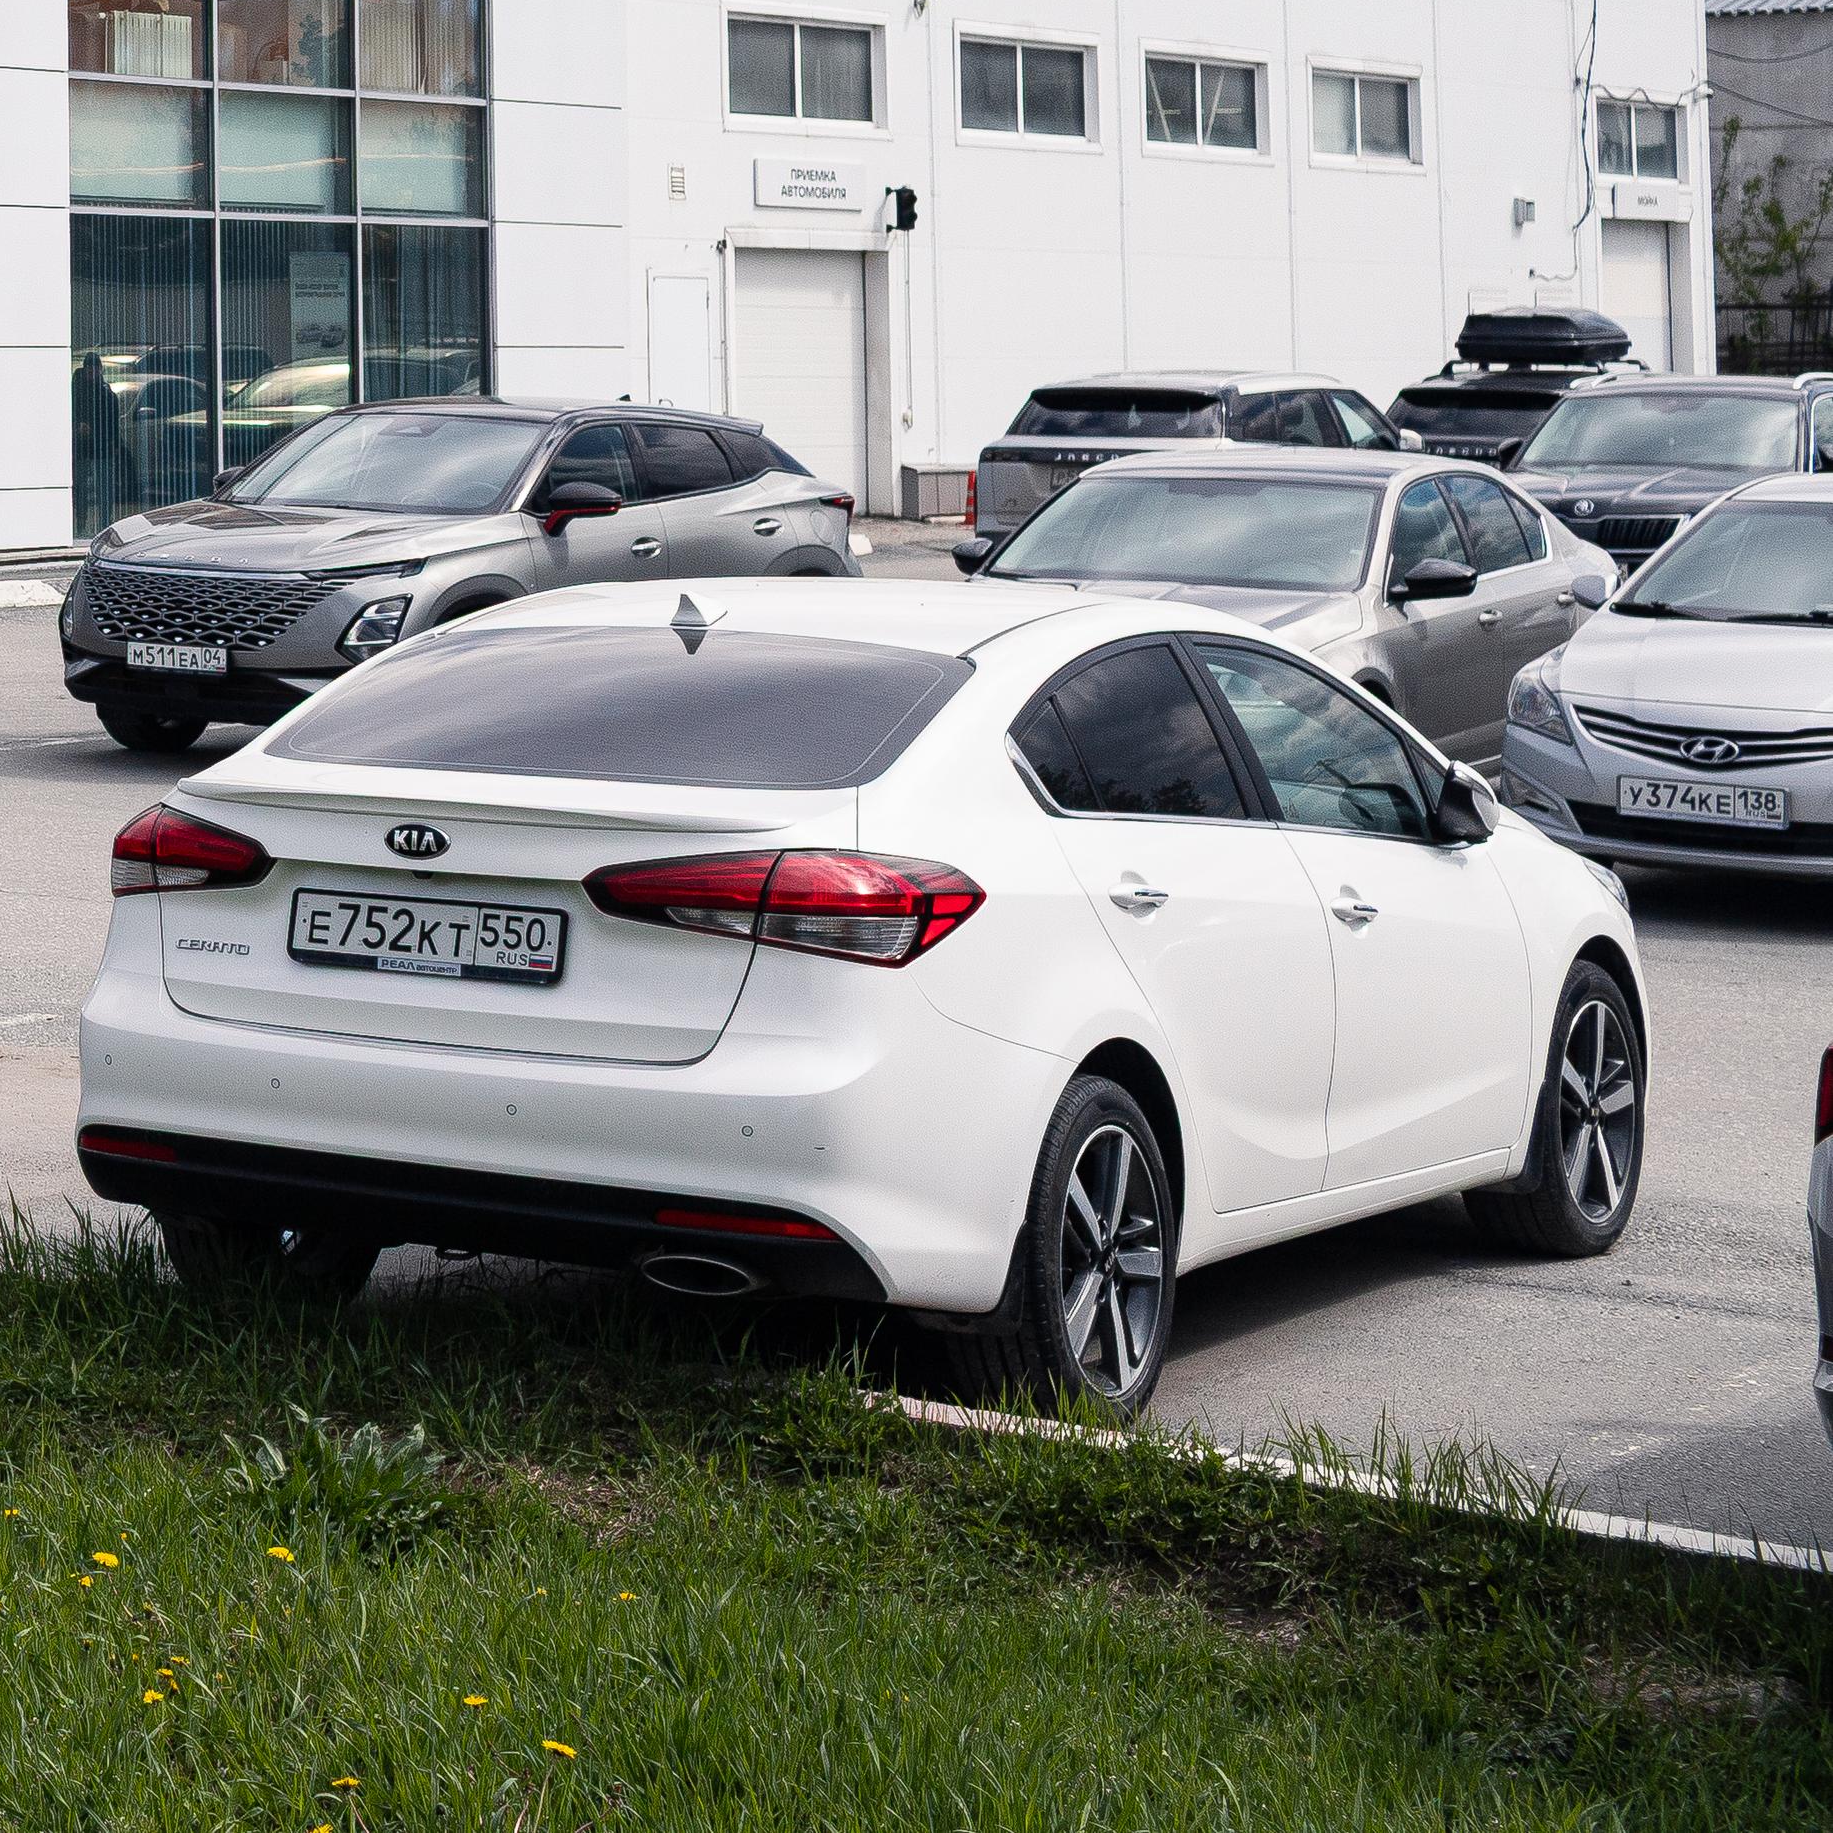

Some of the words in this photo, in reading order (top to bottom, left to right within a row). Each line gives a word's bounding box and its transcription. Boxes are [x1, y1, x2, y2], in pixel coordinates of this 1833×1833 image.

[790, 168, 837, 182] ПРИЕМКА
[780, 185, 847, 200] АВТОМОБИЛЯ
[132, 646, 200, 669] М511ЕА
[202, 648, 222, 665] 04
[1628, 781, 1732, 815] У374КЕ
[1737, 789, 1778, 812] 138
[393, 829, 439, 852] KIA
[306, 901, 471, 959] Е752КТ
[479, 912, 547, 952] 550
[175, 938, 251, 956] CERATO
[381, 958, 416, 971] РЕАЛ
[496, 949, 529, 968] RUS
